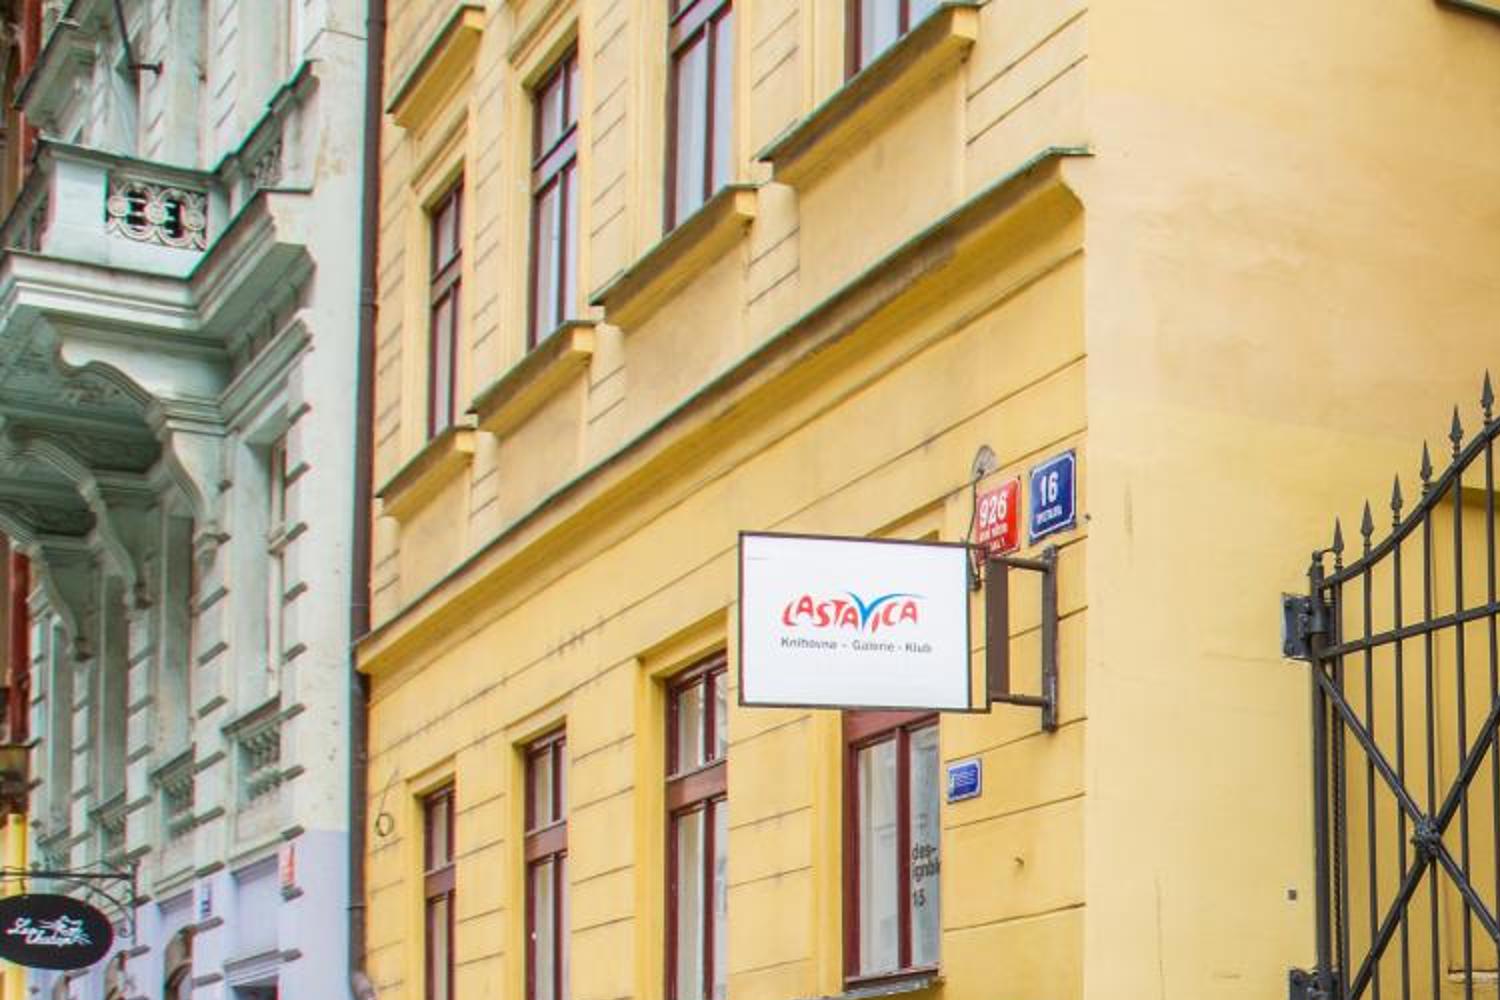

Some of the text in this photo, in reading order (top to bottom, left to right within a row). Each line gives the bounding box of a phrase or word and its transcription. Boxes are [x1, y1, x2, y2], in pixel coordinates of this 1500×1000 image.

[1040, 471, 1059, 507] 16
[979, 489, 1008, 529] 926
[782, 591, 927, 633] LASTAVICA
[780, 637, 838, 650] Knihovna
[852, 639, 895, 652] Galerie
[905, 642, 933, 654] Klub
